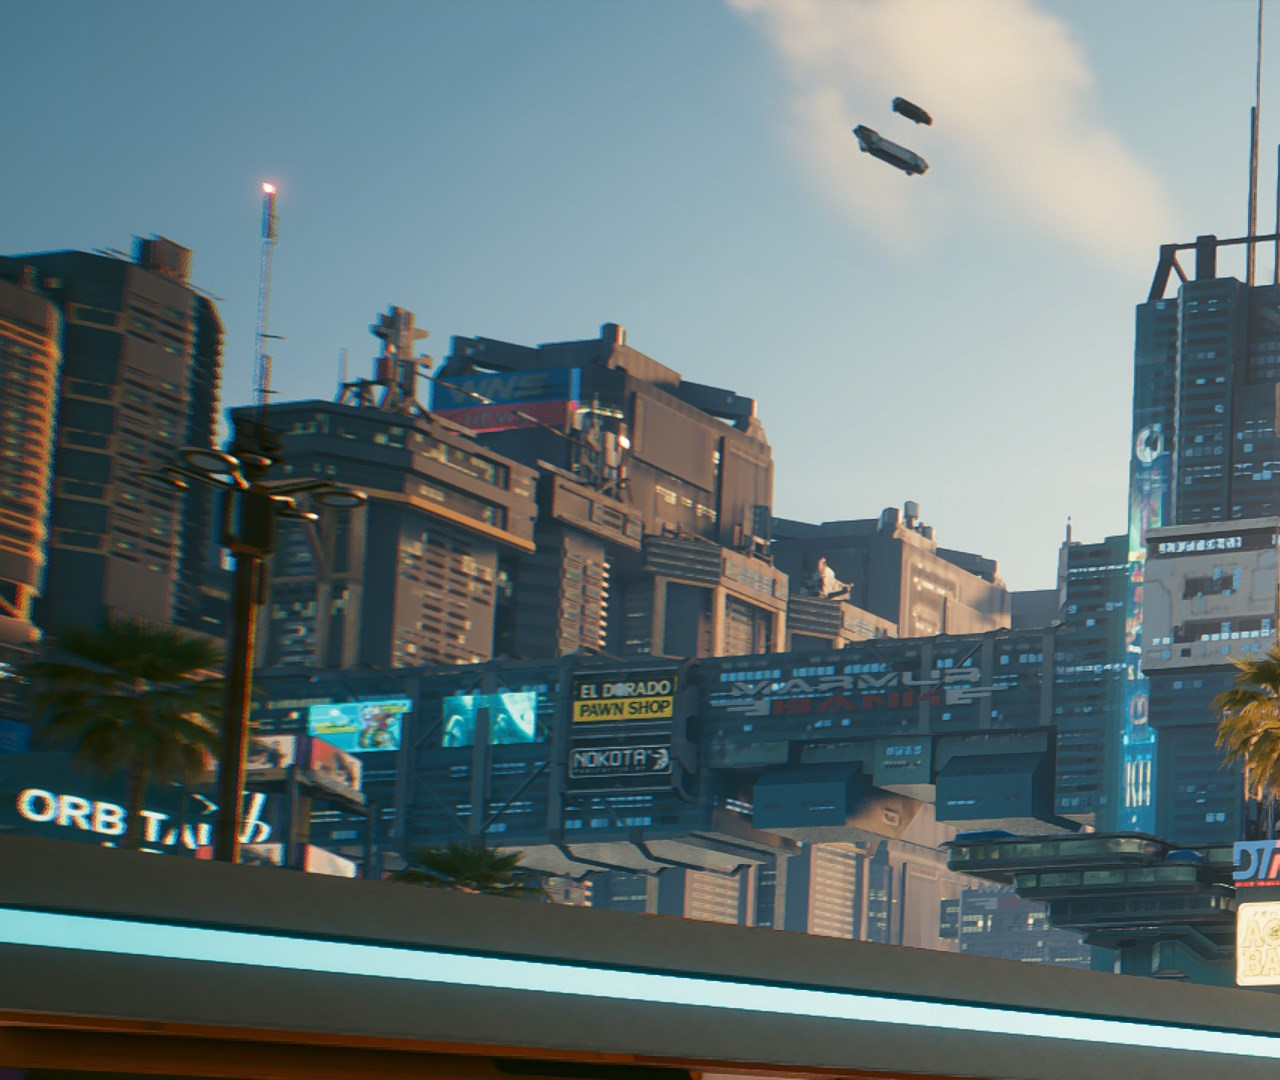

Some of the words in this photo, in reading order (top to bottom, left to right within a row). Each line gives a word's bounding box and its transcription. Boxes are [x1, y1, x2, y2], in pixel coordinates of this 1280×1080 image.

[581, 684, 598, 698] EL
[580, 702, 624, 717] PAWN
[627, 700, 671, 715] SHOP
[574, 749, 647, 768] NOKOTA
